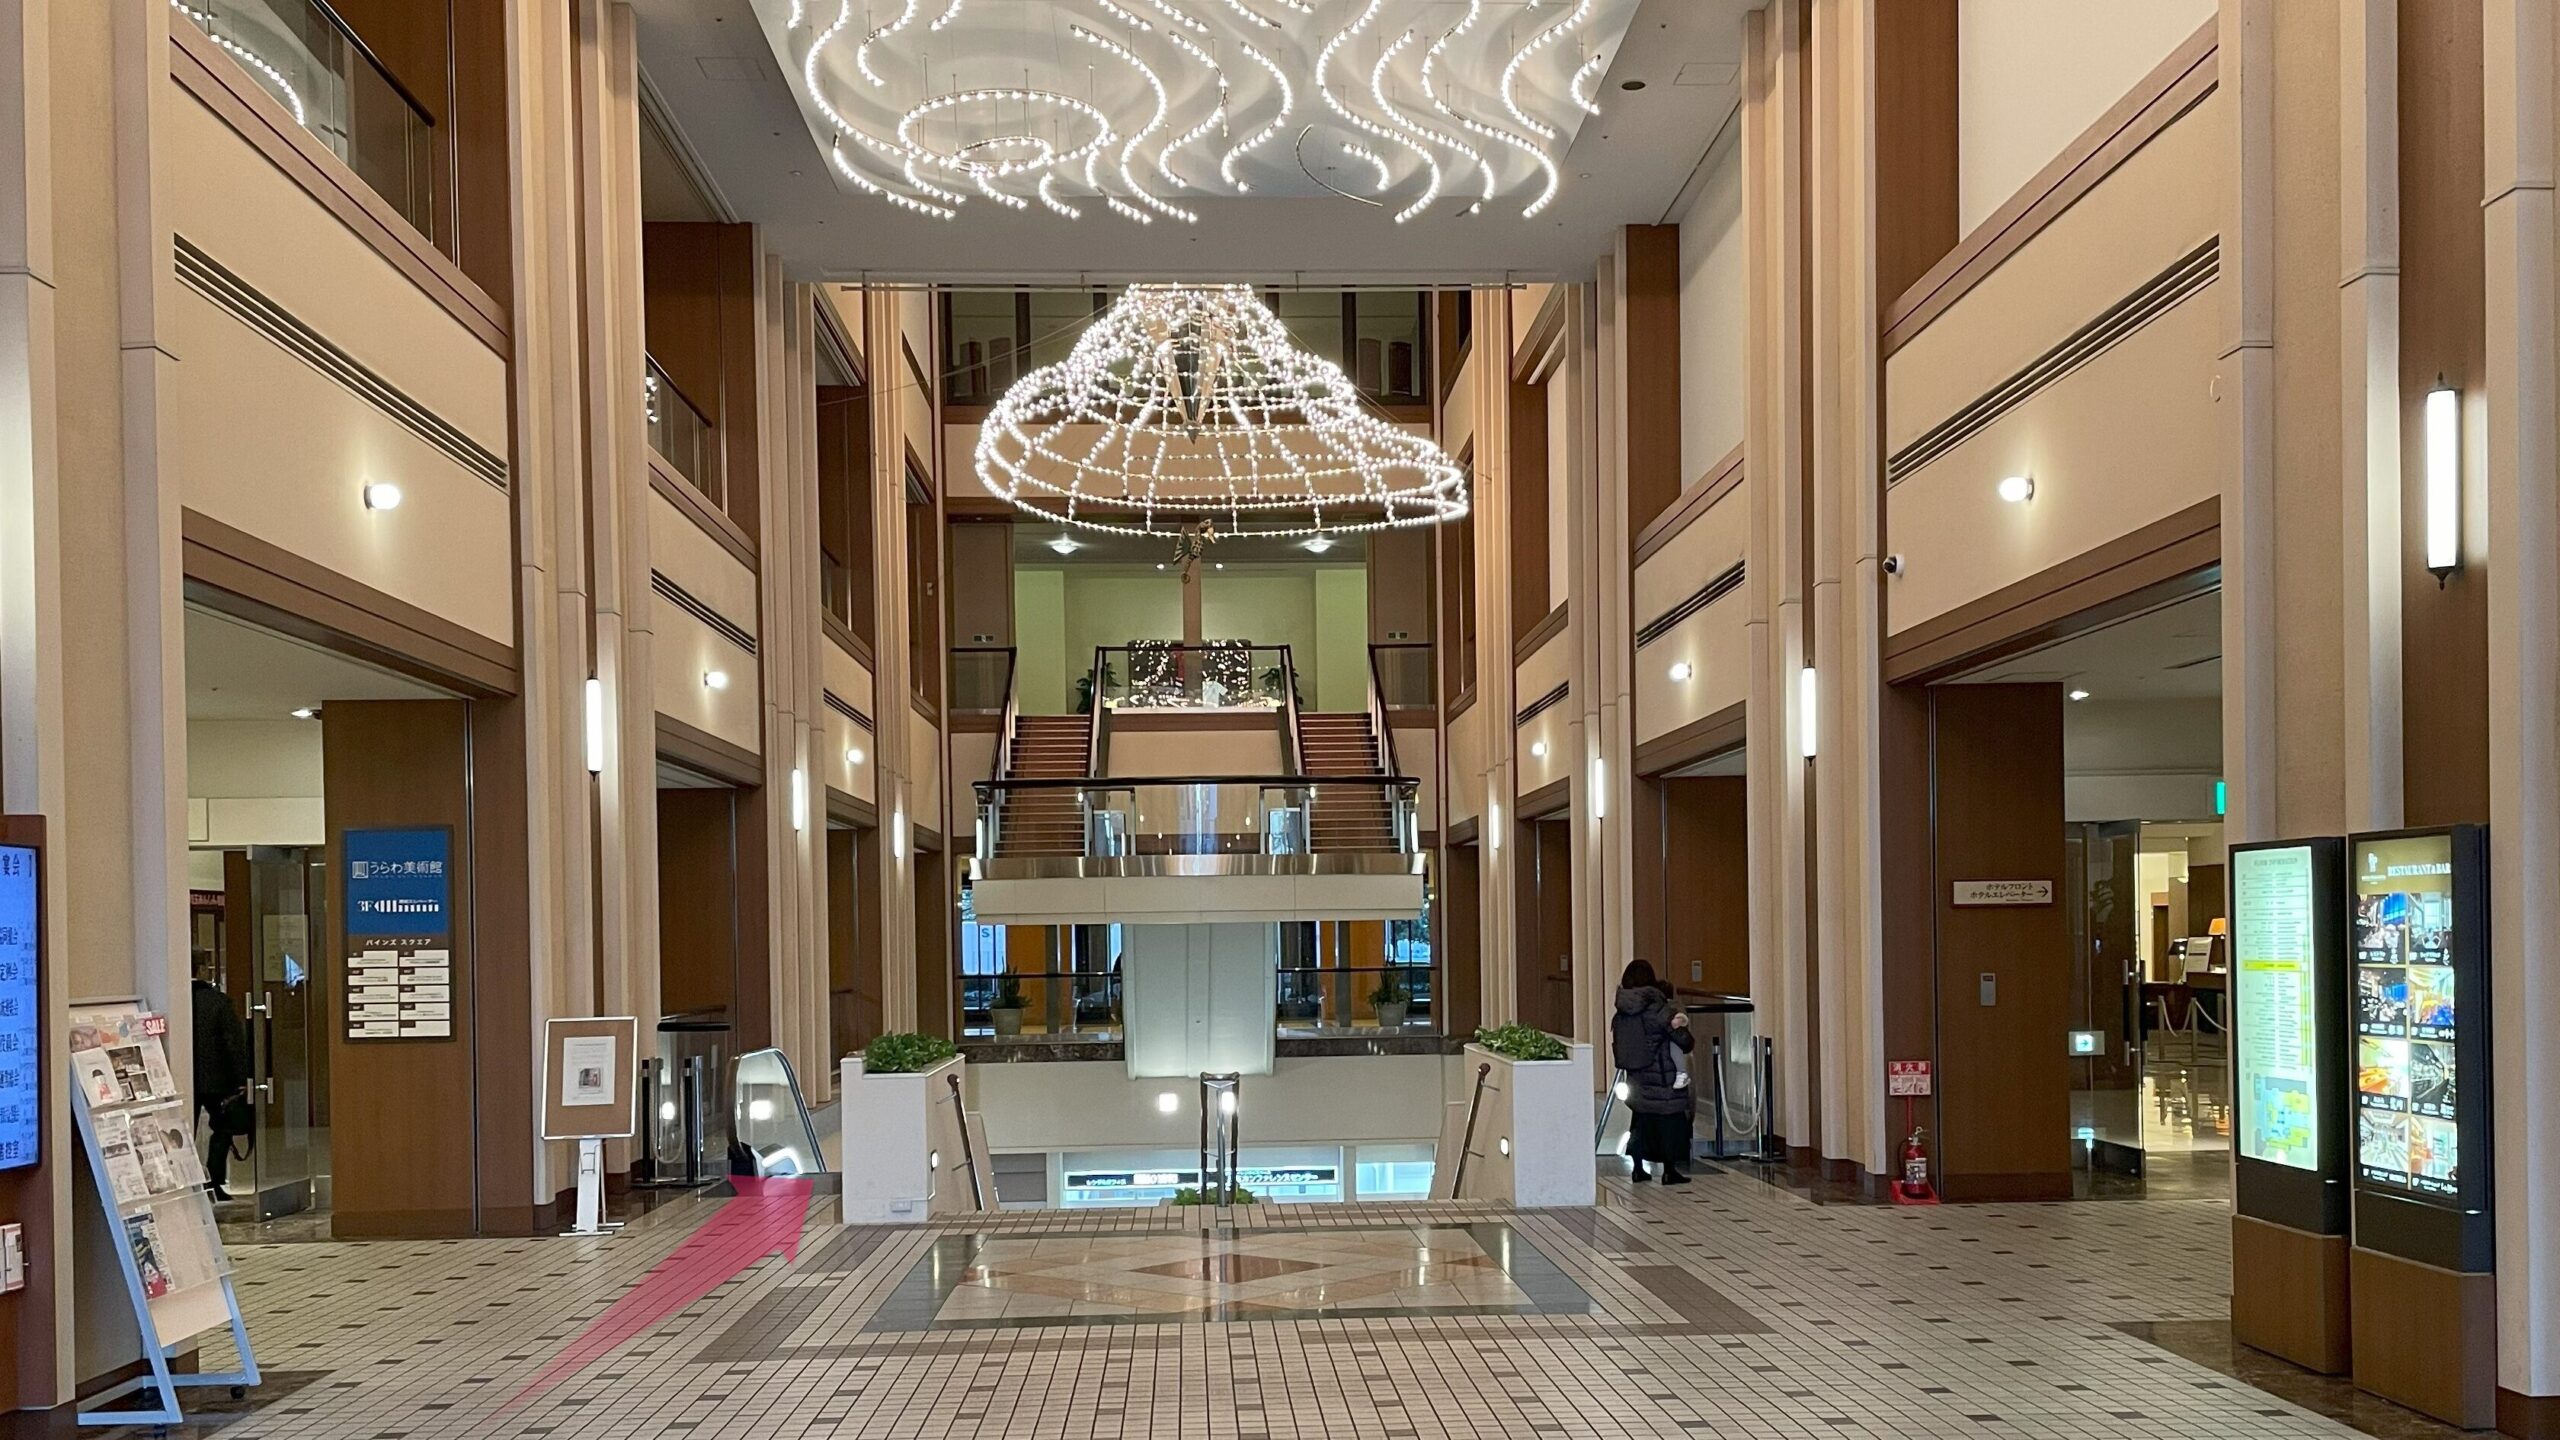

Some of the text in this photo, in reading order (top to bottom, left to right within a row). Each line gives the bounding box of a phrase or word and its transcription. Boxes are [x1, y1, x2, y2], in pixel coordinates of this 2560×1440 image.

[370, 860, 443, 874] うらわ美術館
[1986, 883, 2034, 891] ホテルフロント
[1970, 891, 2034, 899] ホテルエレベーター
[357, 900, 374, 912] 3F
[145, 1018, 166, 1035] SALE
